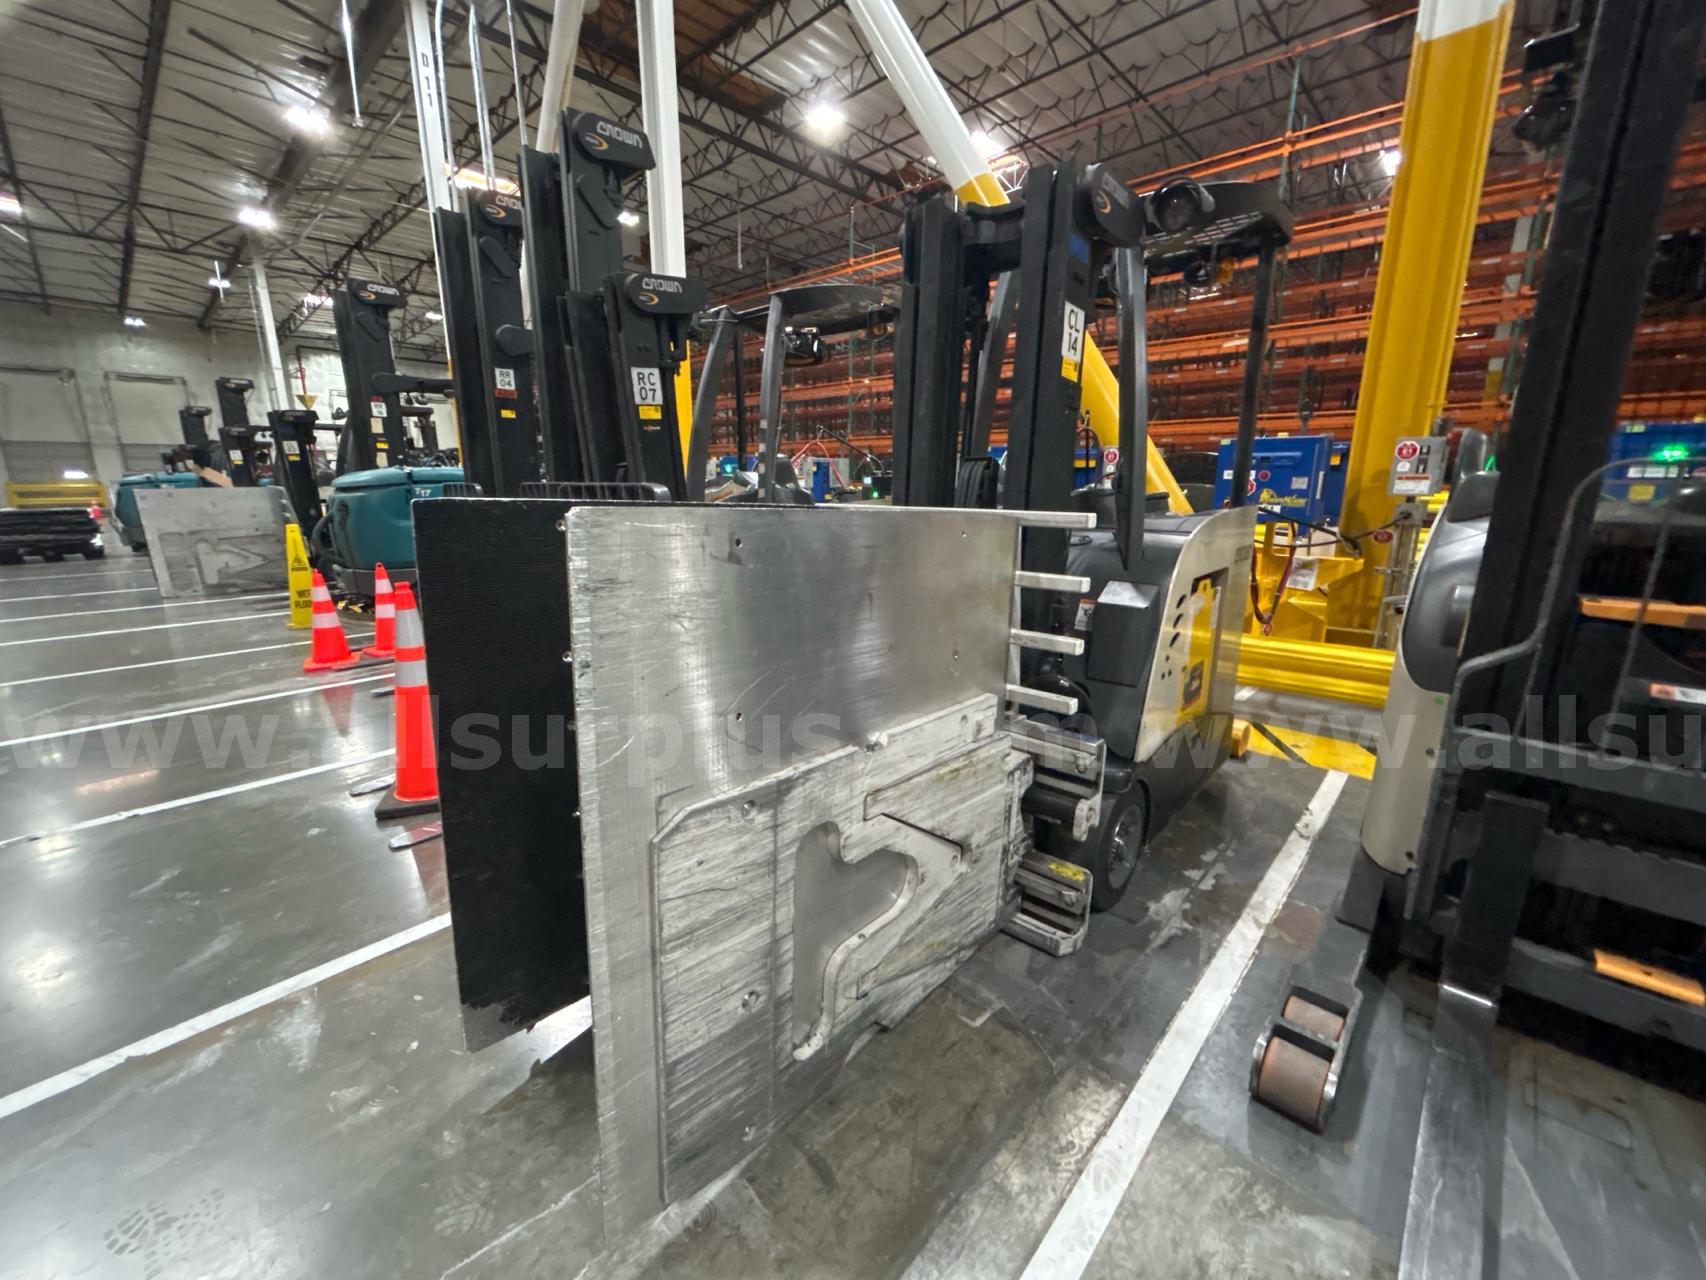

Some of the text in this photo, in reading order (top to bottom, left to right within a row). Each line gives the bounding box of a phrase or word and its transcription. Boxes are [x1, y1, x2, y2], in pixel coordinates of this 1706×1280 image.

[596, 121, 643, 149] CROWN
[495, 195, 522, 210] CRO
[367, 283, 400, 296] CROWN
[642, 277, 683, 293] CROWN
[1068, 308, 1080, 333] CL
[1068, 332, 1078, 356] 14
[637, 372, 656, 386] RC
[640, 387, 656, 402] 07
[414, 487, 432, 497] T17
